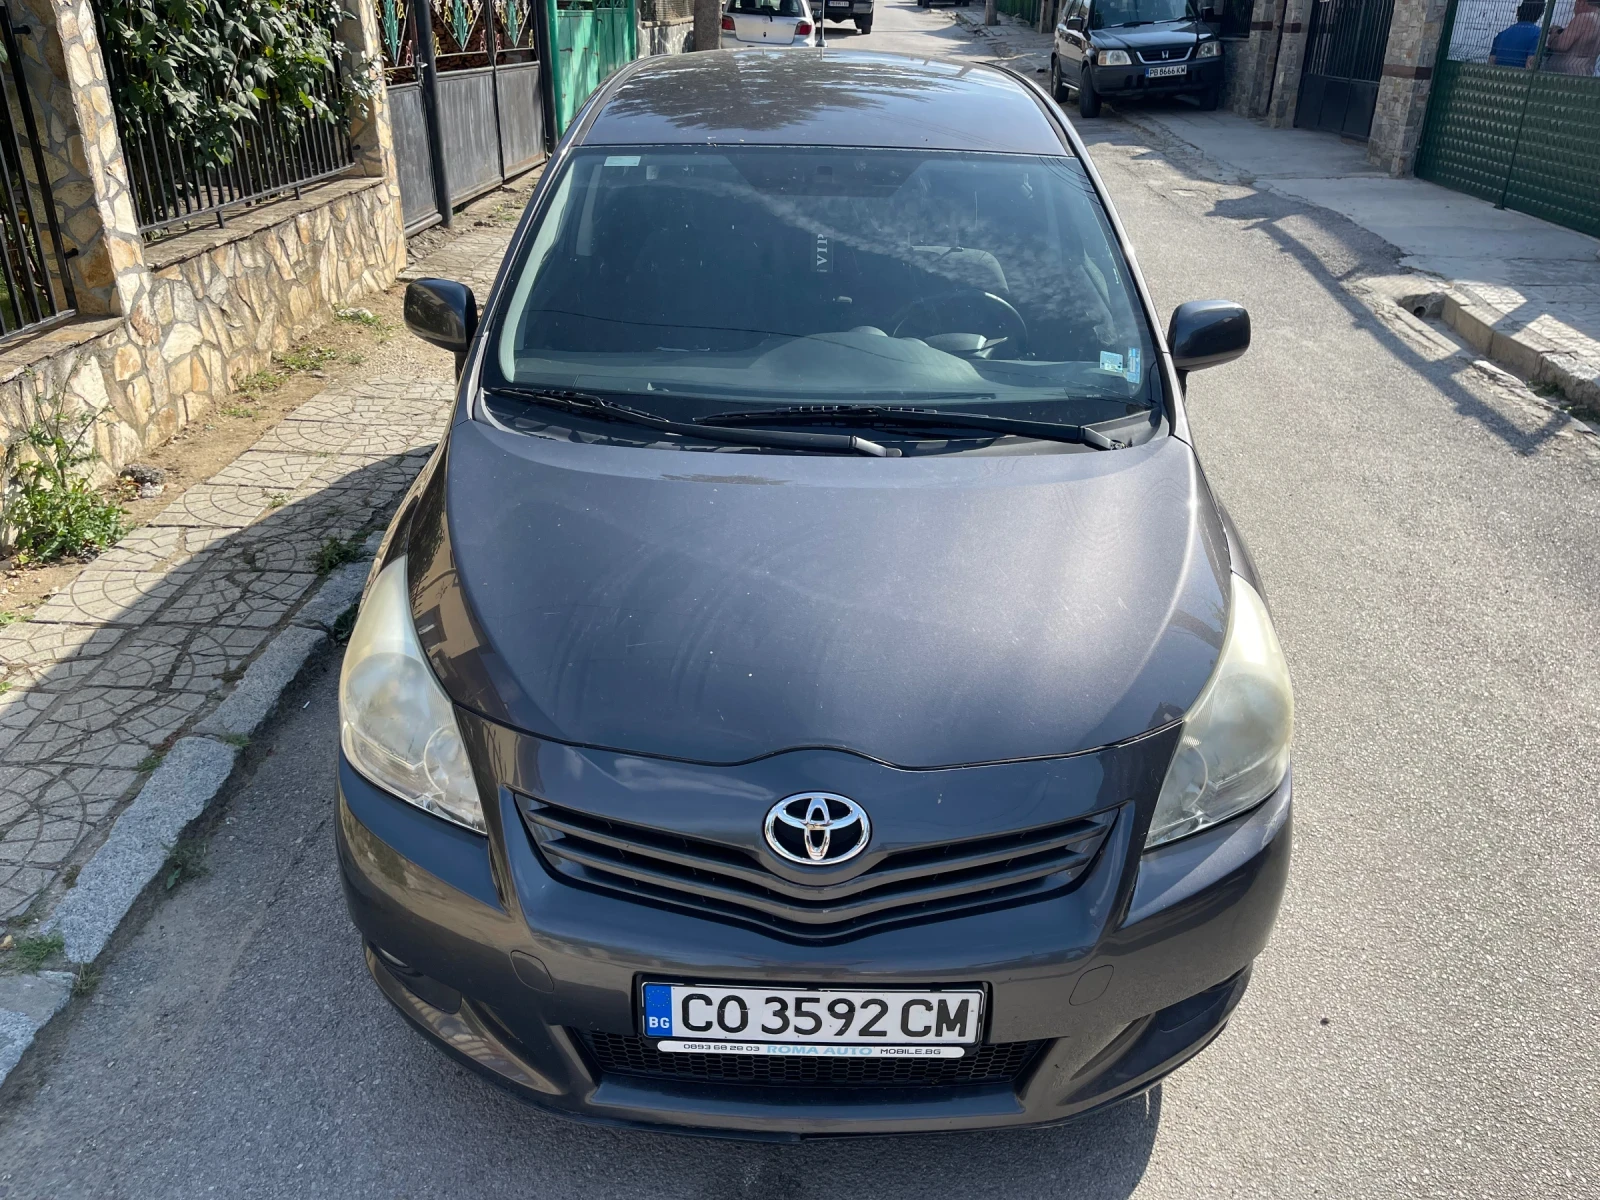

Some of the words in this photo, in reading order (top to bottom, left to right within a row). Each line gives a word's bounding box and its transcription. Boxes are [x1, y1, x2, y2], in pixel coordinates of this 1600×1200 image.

[1149, 69, 1158, 77] PB
[816, 233, 828, 266] VIP
[682, 993, 748, 1033] CO
[761, 996, 889, 1036] 3592
[900, 998, 970, 1037] CM
[649, 1017, 670, 1029] BG
[767, 1045, 819, 1055] ROMA
[823, 1046, 873, 1056] AUTO
